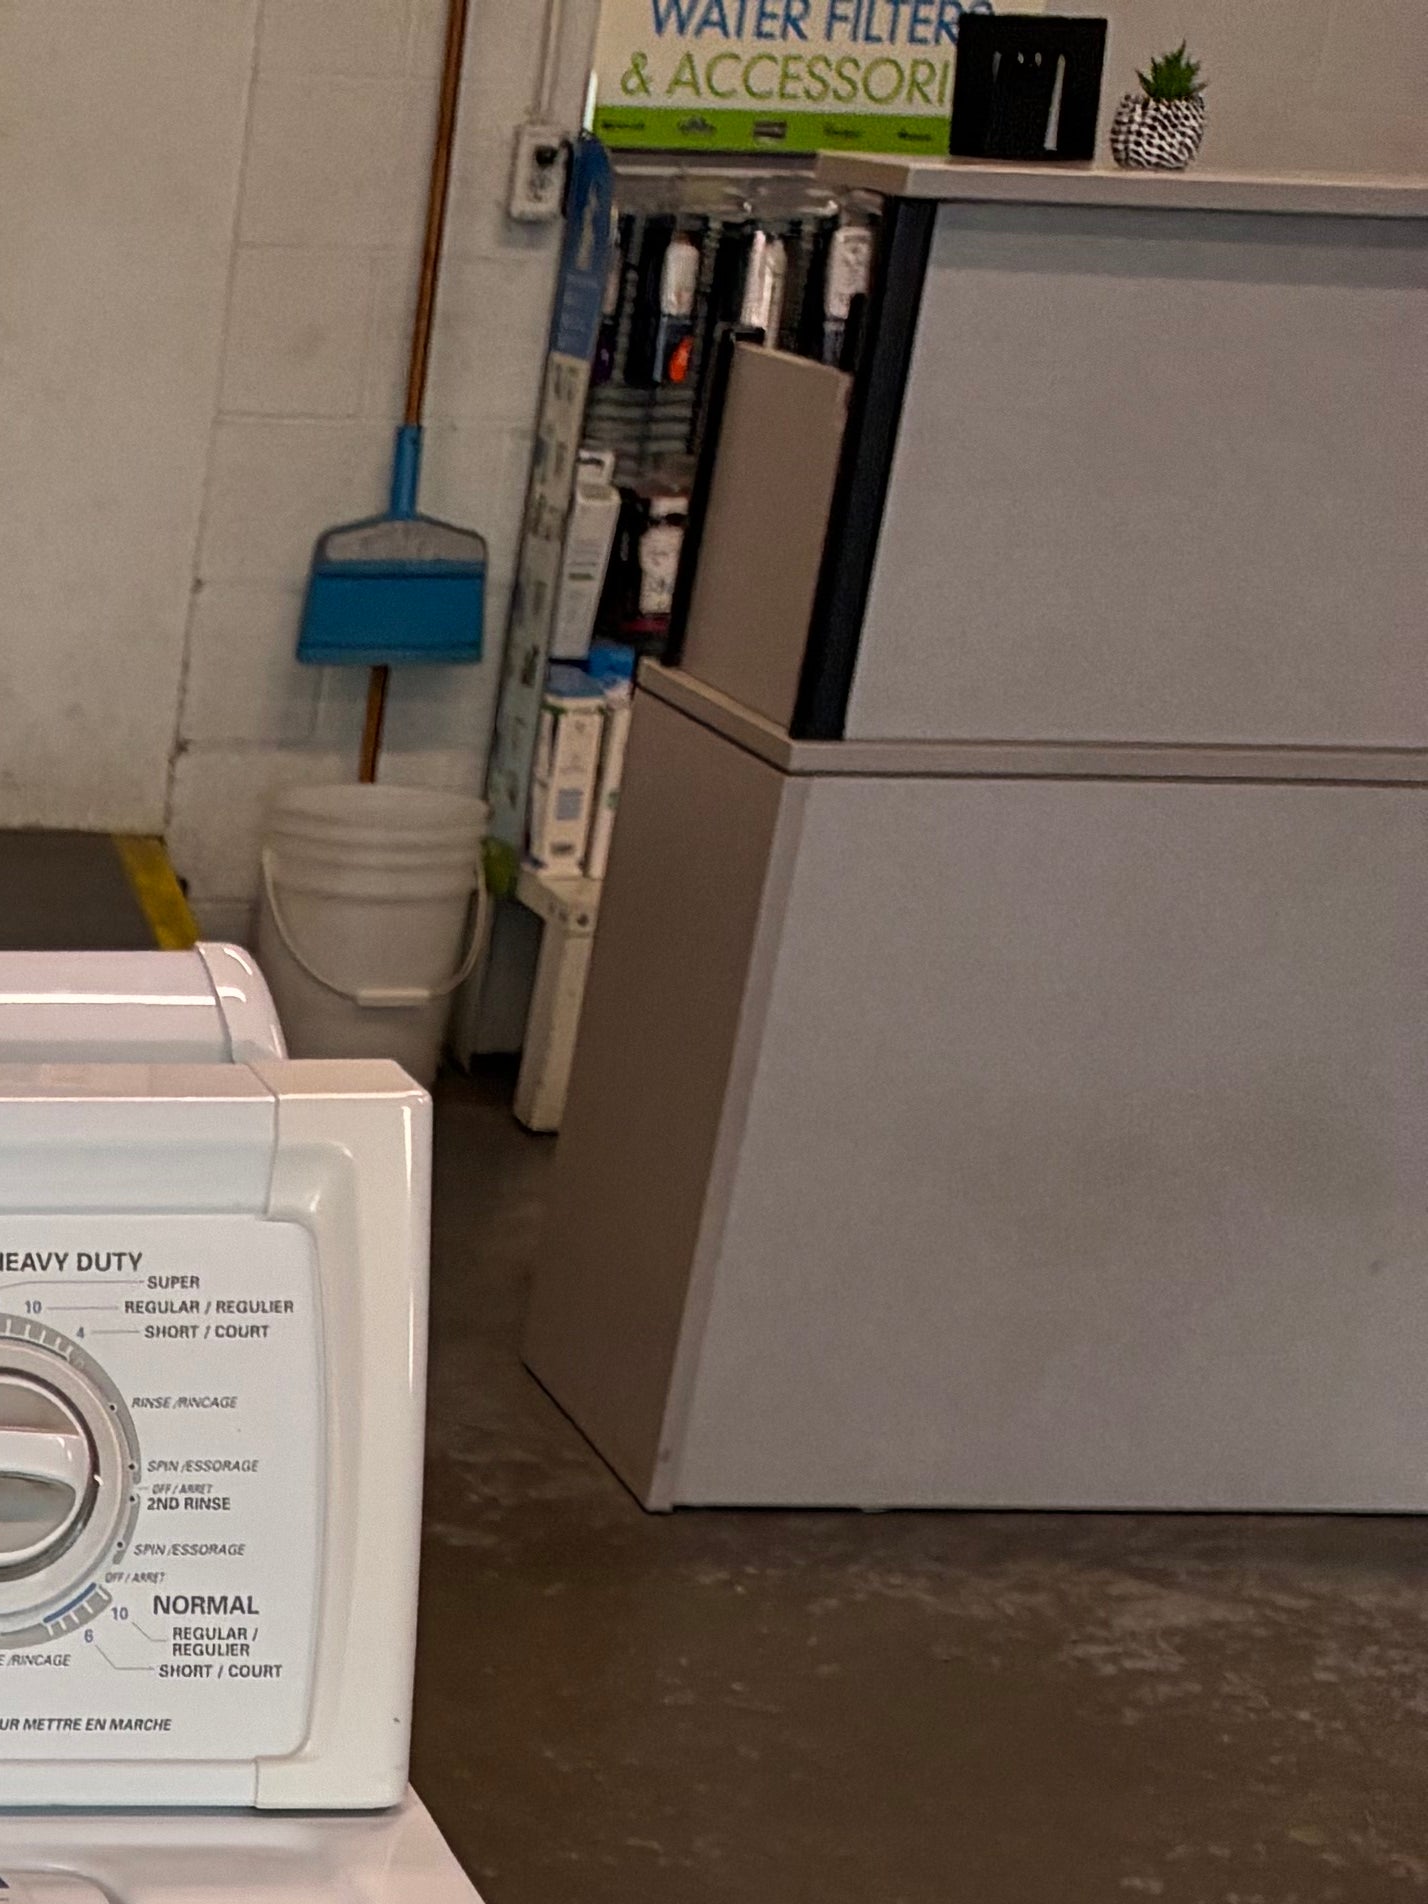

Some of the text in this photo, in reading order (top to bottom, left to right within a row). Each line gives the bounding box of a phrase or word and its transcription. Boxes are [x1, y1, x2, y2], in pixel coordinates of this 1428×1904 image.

[620, 51, 950, 106] & ACCESSORI
[76, 1252, 143, 1272] DUTY
[146, 1276, 200, 1290] SUPER
[25, 1301, 42, 1315] 10
[124, 1300, 294, 1315] REGULAR REGULIER
[76, 1327, 85, 1339] 4
[144, 1325, 270, 1339] SHORT COURT
[132, 1397, 171, 1409] RINSE
[147, 1460, 179, 1472] SPIN
[147, 1497, 231, 1511] 2ND RINSE
[134, 1544, 165, 1556] SPIN
[153, 1595, 260, 1615] NORMAL
[112, 1607, 129, 1621] 10
[84, 1630, 94, 1643] 6
[172, 1627, 247, 1641] REGULAR
[172, 1643, 250, 1656] REGULIER
[158, 1664, 283, 1678] SHORT COURT
[22, 1718, 82, 1731] METTRE
[84, 1718, 106, 1731] EN
[109, 1718, 172, 1731] MARCHE
